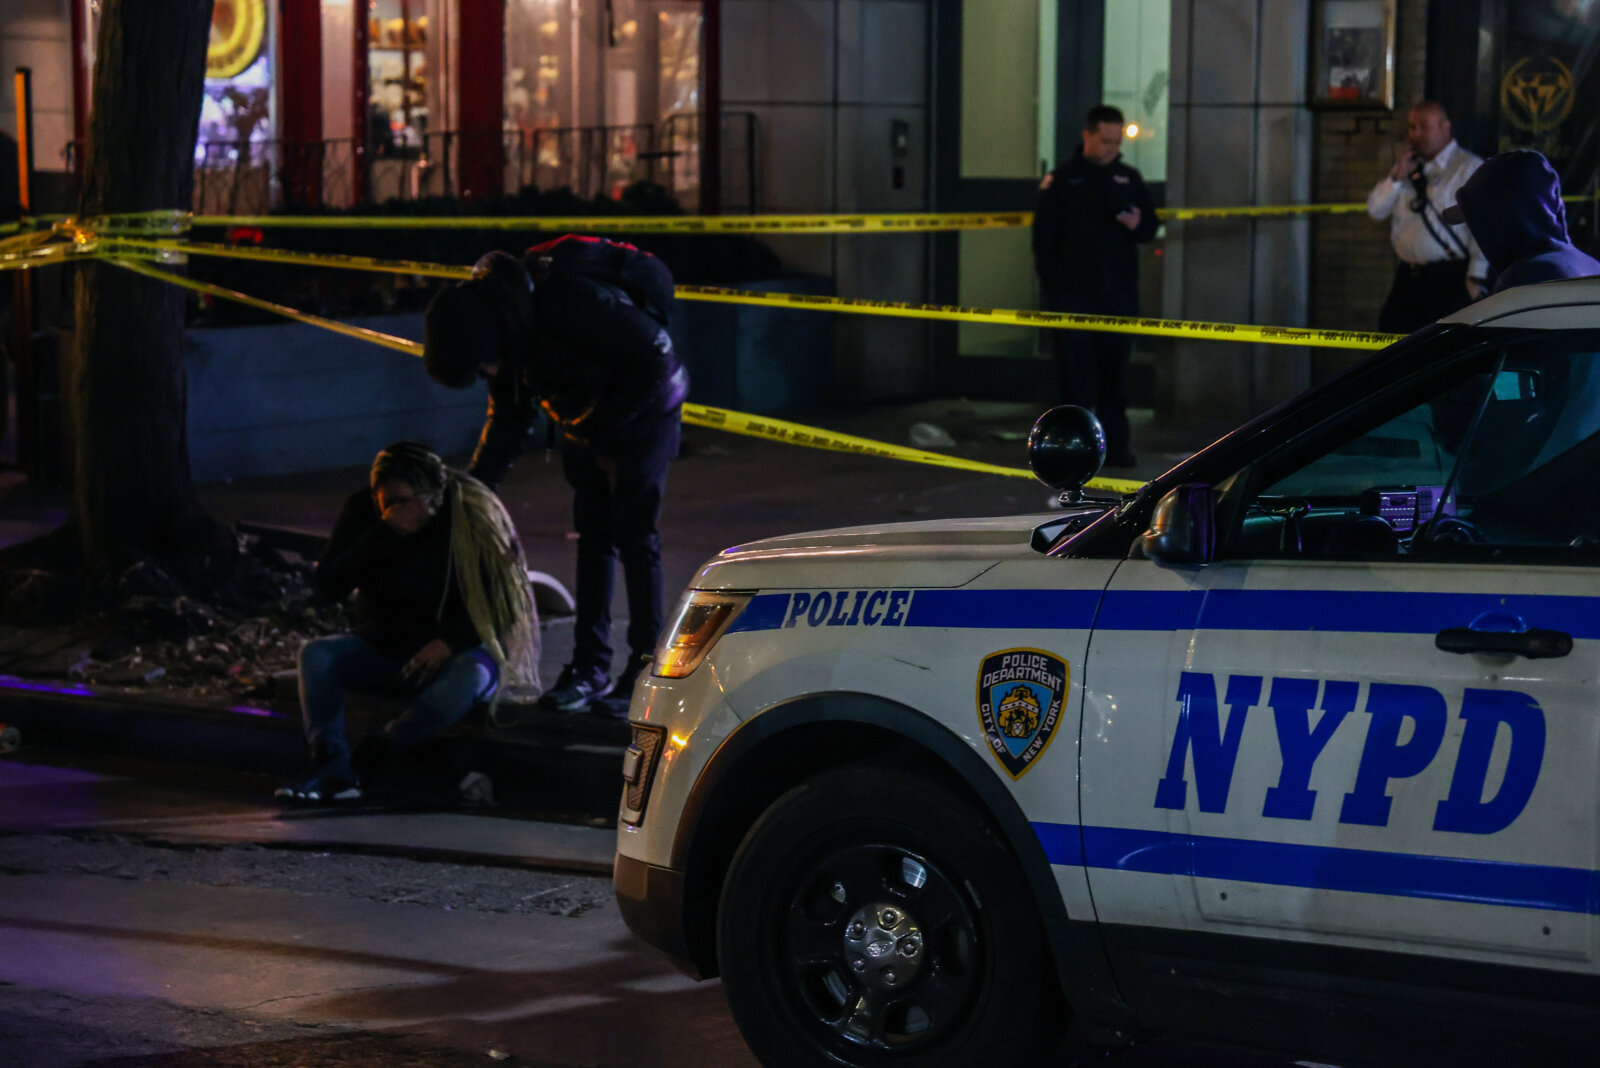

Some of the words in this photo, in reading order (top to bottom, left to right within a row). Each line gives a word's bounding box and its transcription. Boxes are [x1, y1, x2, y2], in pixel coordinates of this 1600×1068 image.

[784, 590, 911, 628] POLICE
[982, 667, 1062, 692] DEPARTMENT
[1002, 654, 1048, 671] POLICE
[981, 703, 996, 733] CITY
[992, 739, 1006, 754] OF
[1022, 737, 1043, 762] NEW
[1042, 699, 1061, 732] YORK
[1154, 671, 1547, 835] NYPD
